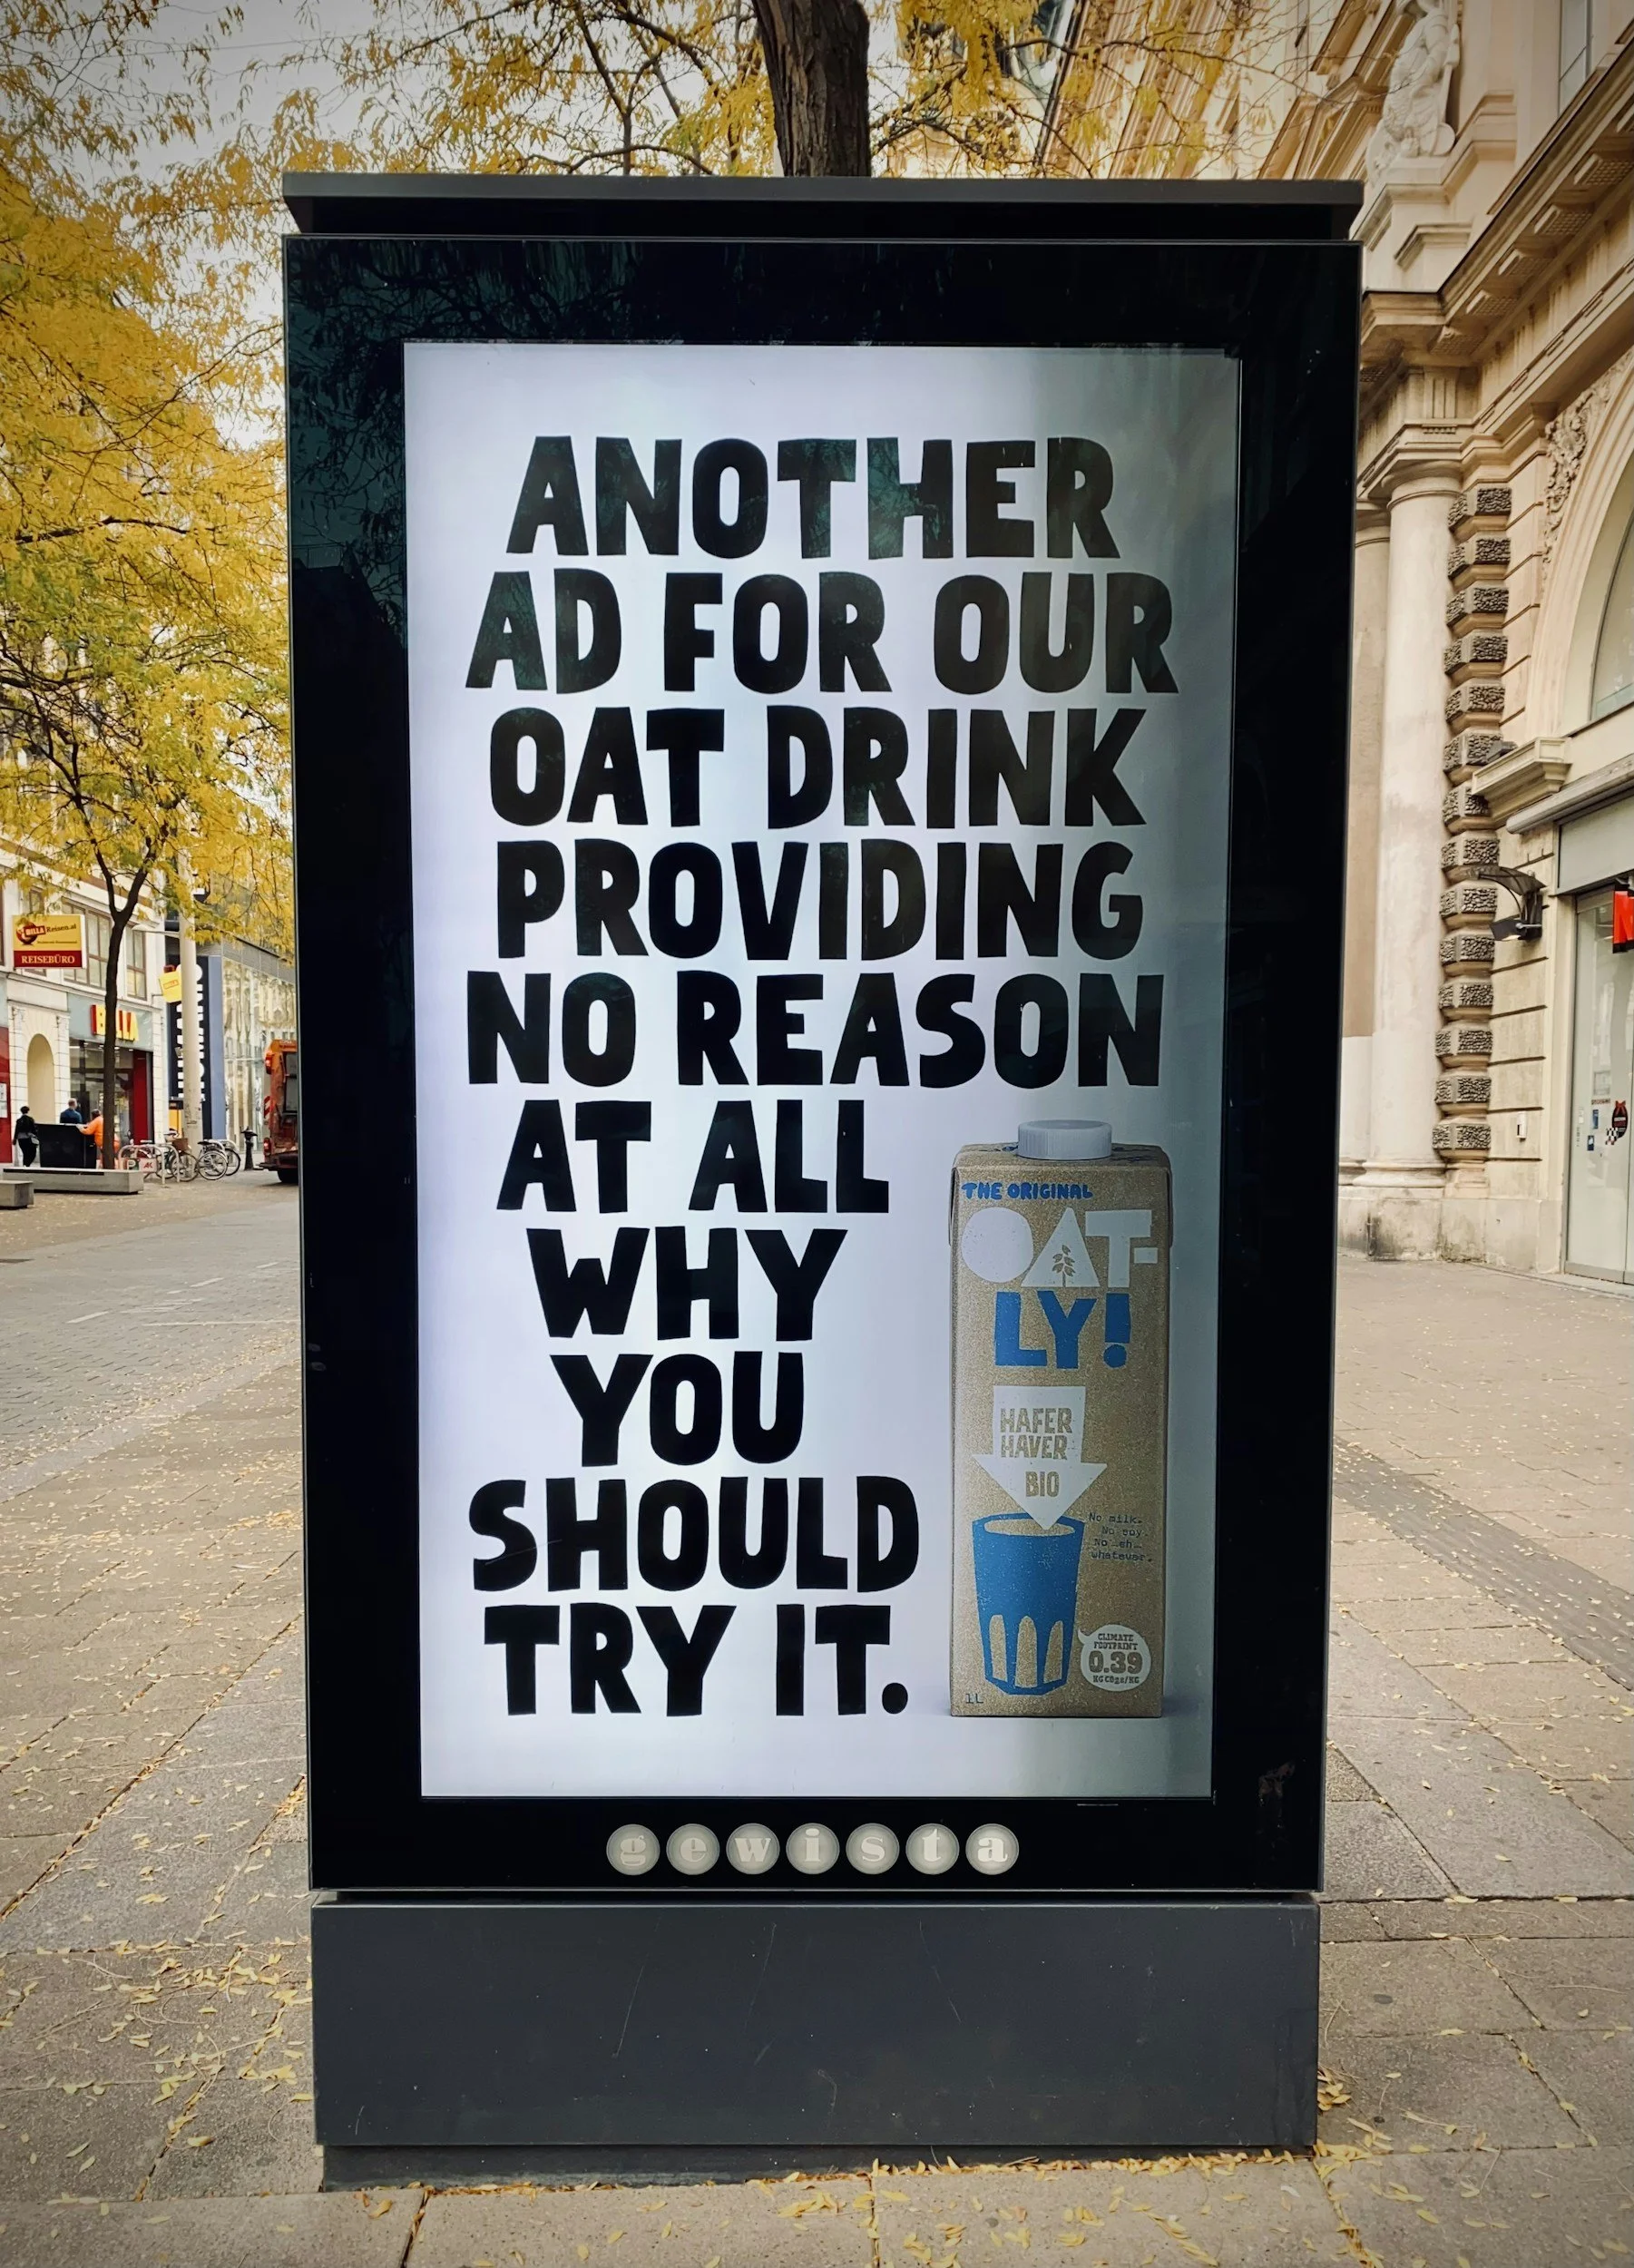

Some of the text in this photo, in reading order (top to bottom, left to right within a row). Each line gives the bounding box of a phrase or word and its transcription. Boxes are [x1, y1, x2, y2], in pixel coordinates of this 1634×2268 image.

[506, 436, 1120, 559] ANOTHER
[465, 569, 1180, 695] AD FOR OUR
[491, 706, 1147, 829] OAT DRINK
[498, 839, 1143, 961] PROVIDING
[21, 954, 75, 963] REISEBÜRO
[91, 1003, 139, 1041] BLLA
[467, 971, 1164, 1089] NO REASON
[497, 1100, 888, 1213] AT ALL
[961, 1182, 1093, 1200] THE ORIGINAL
[526, 1227, 847, 1341] WHY
[994, 1290, 1131, 1369] LY!
[551, 1352, 804, 1467] YOU
[1000, 1407, 1072, 1434] HAFER
[1001, 1434, 1068, 1461] HAVER
[1025, 1471, 1060, 1497] BIO
[469, 1476, 918, 1592] SHOULD
[1089, 1512, 1142, 1524] No milk.
[1101, 1526, 1149, 1538] No soy.
[1094, 1538, 1108, 1547] No
[1094, 1641, 1138, 1650] FOOTPRINT
[1098, 1633, 1134, 1642] CLIMATE
[484, 1603, 908, 1716] TRY IT.
[1089, 1650, 1143, 1675] 0.39
[965, 1693, 983, 1704] 1L
[620, 1827, 1008, 1866] gewista
